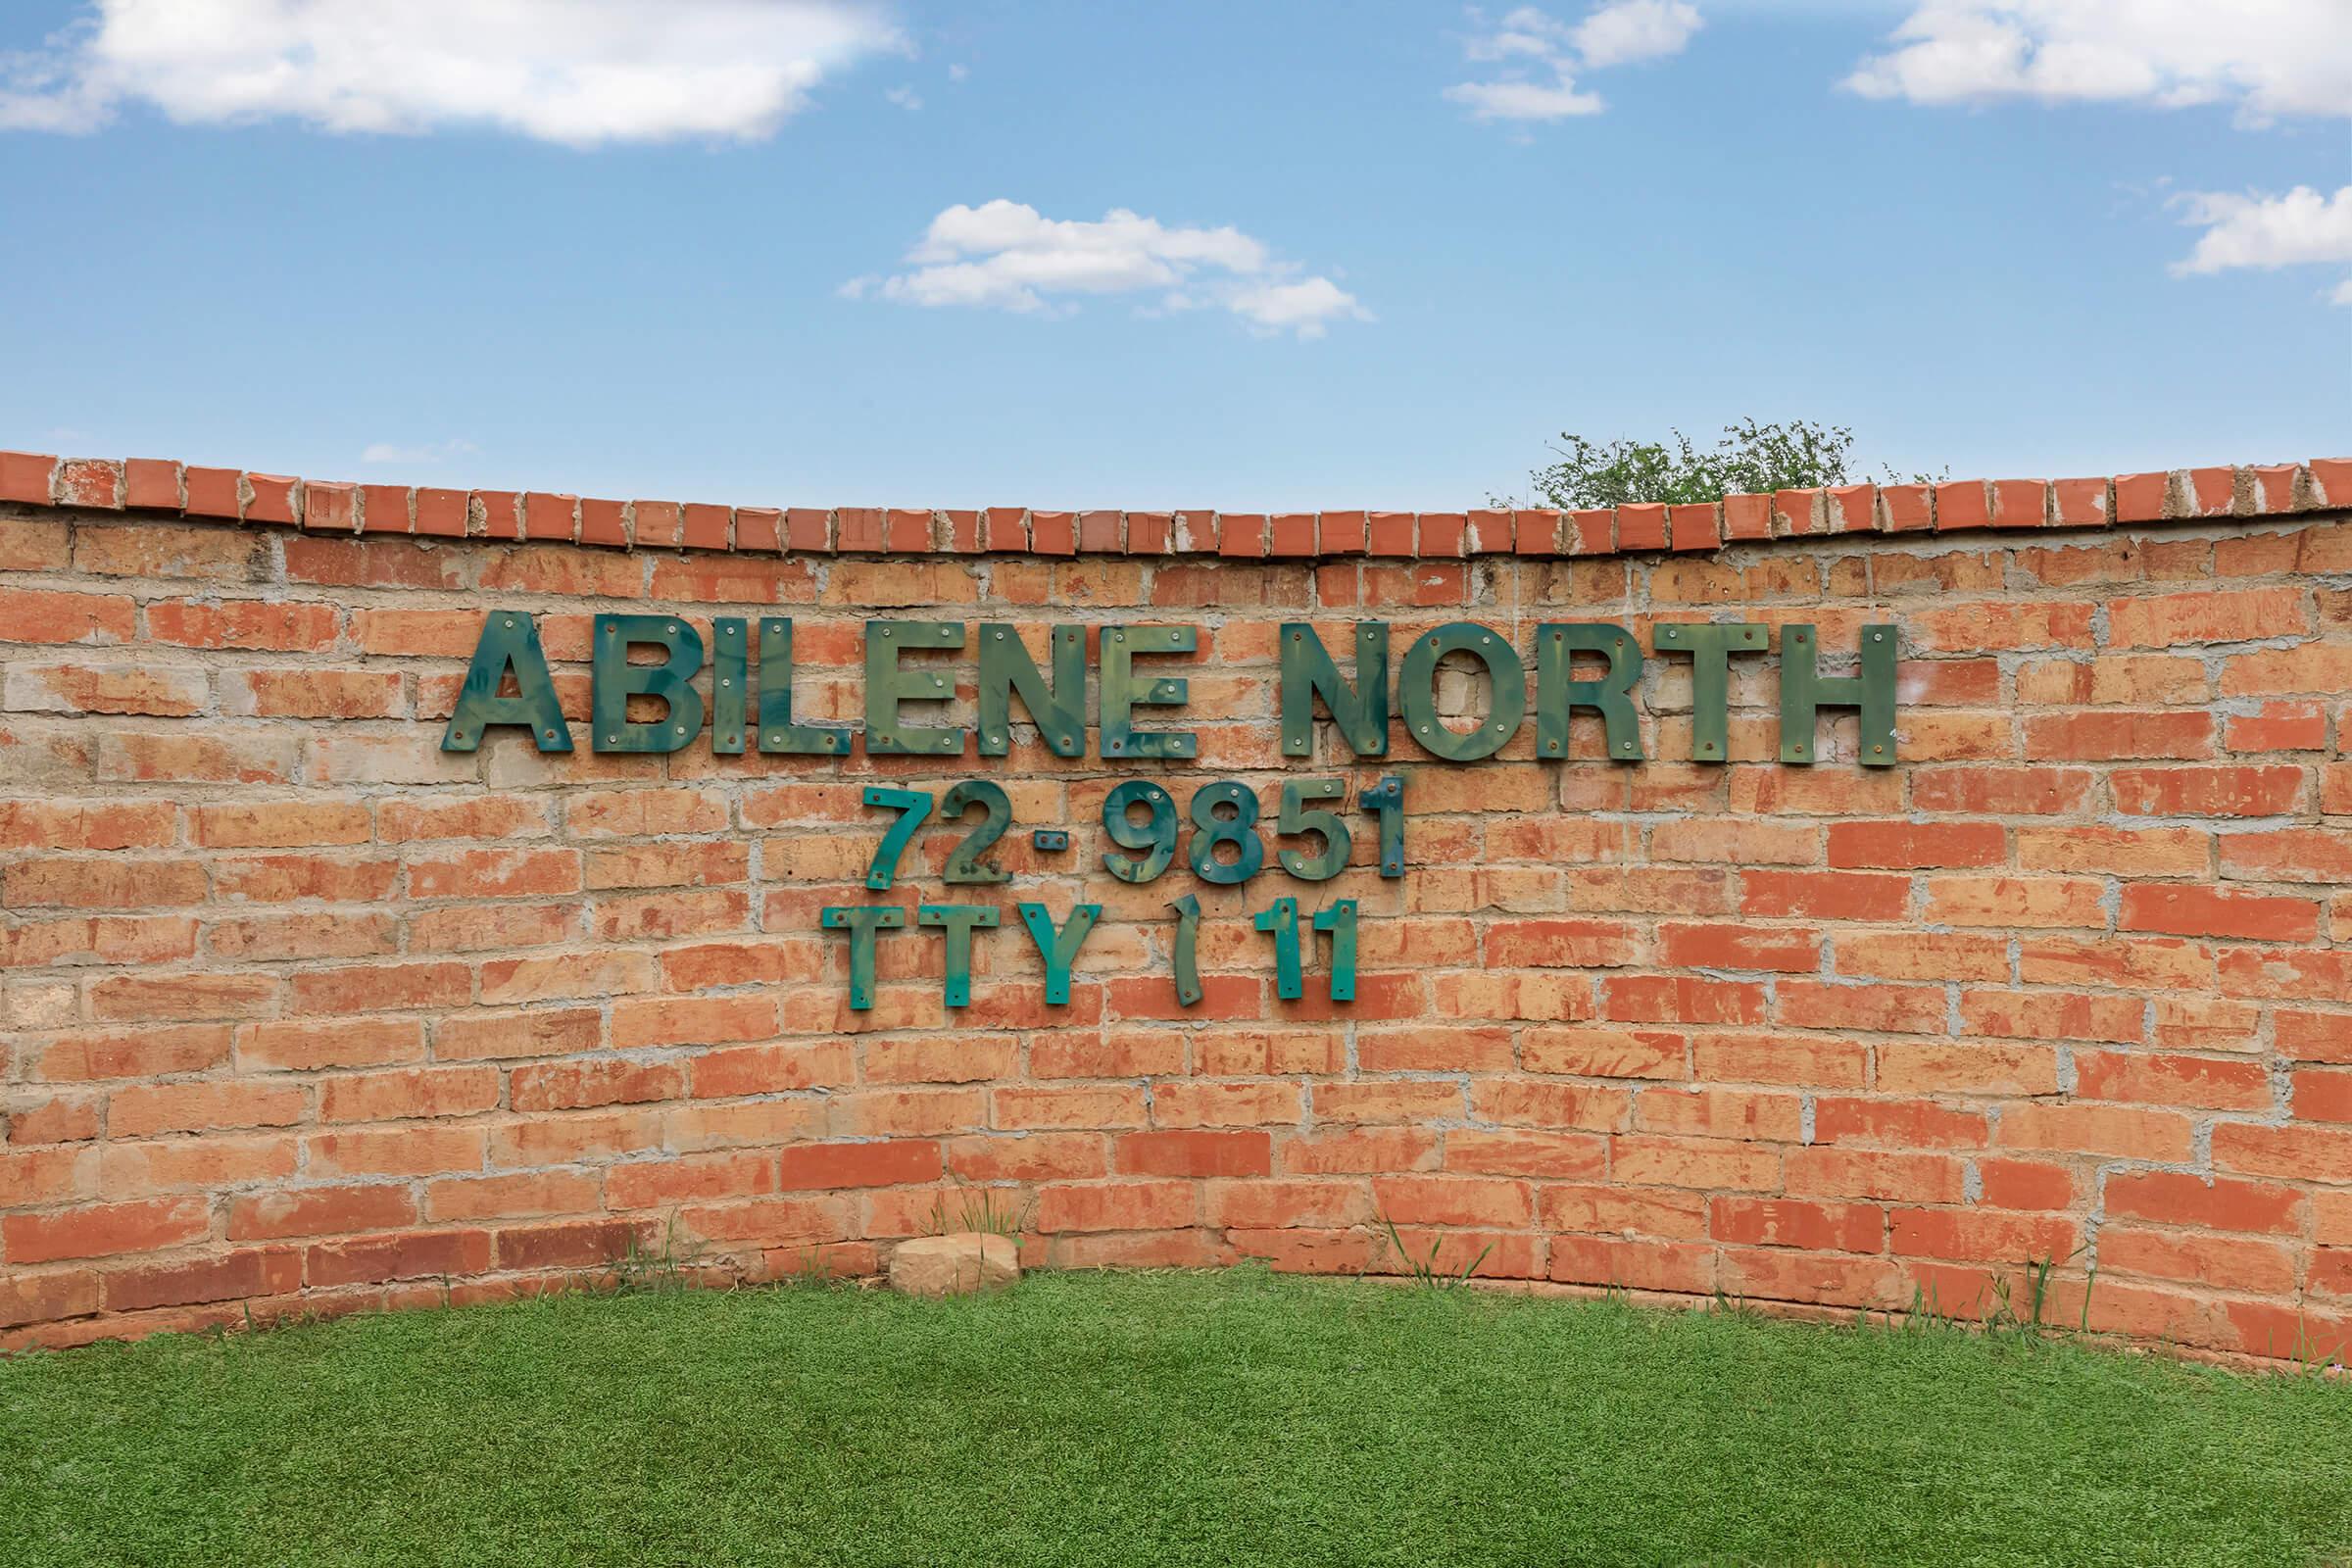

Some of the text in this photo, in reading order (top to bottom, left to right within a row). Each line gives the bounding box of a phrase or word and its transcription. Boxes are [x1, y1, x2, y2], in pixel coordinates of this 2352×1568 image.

[441, 612, 1897, 765] ABILENE NORTH
[863, 778, 1404, 890] 72-9851
[822, 903, 1102, 1009] TTY
